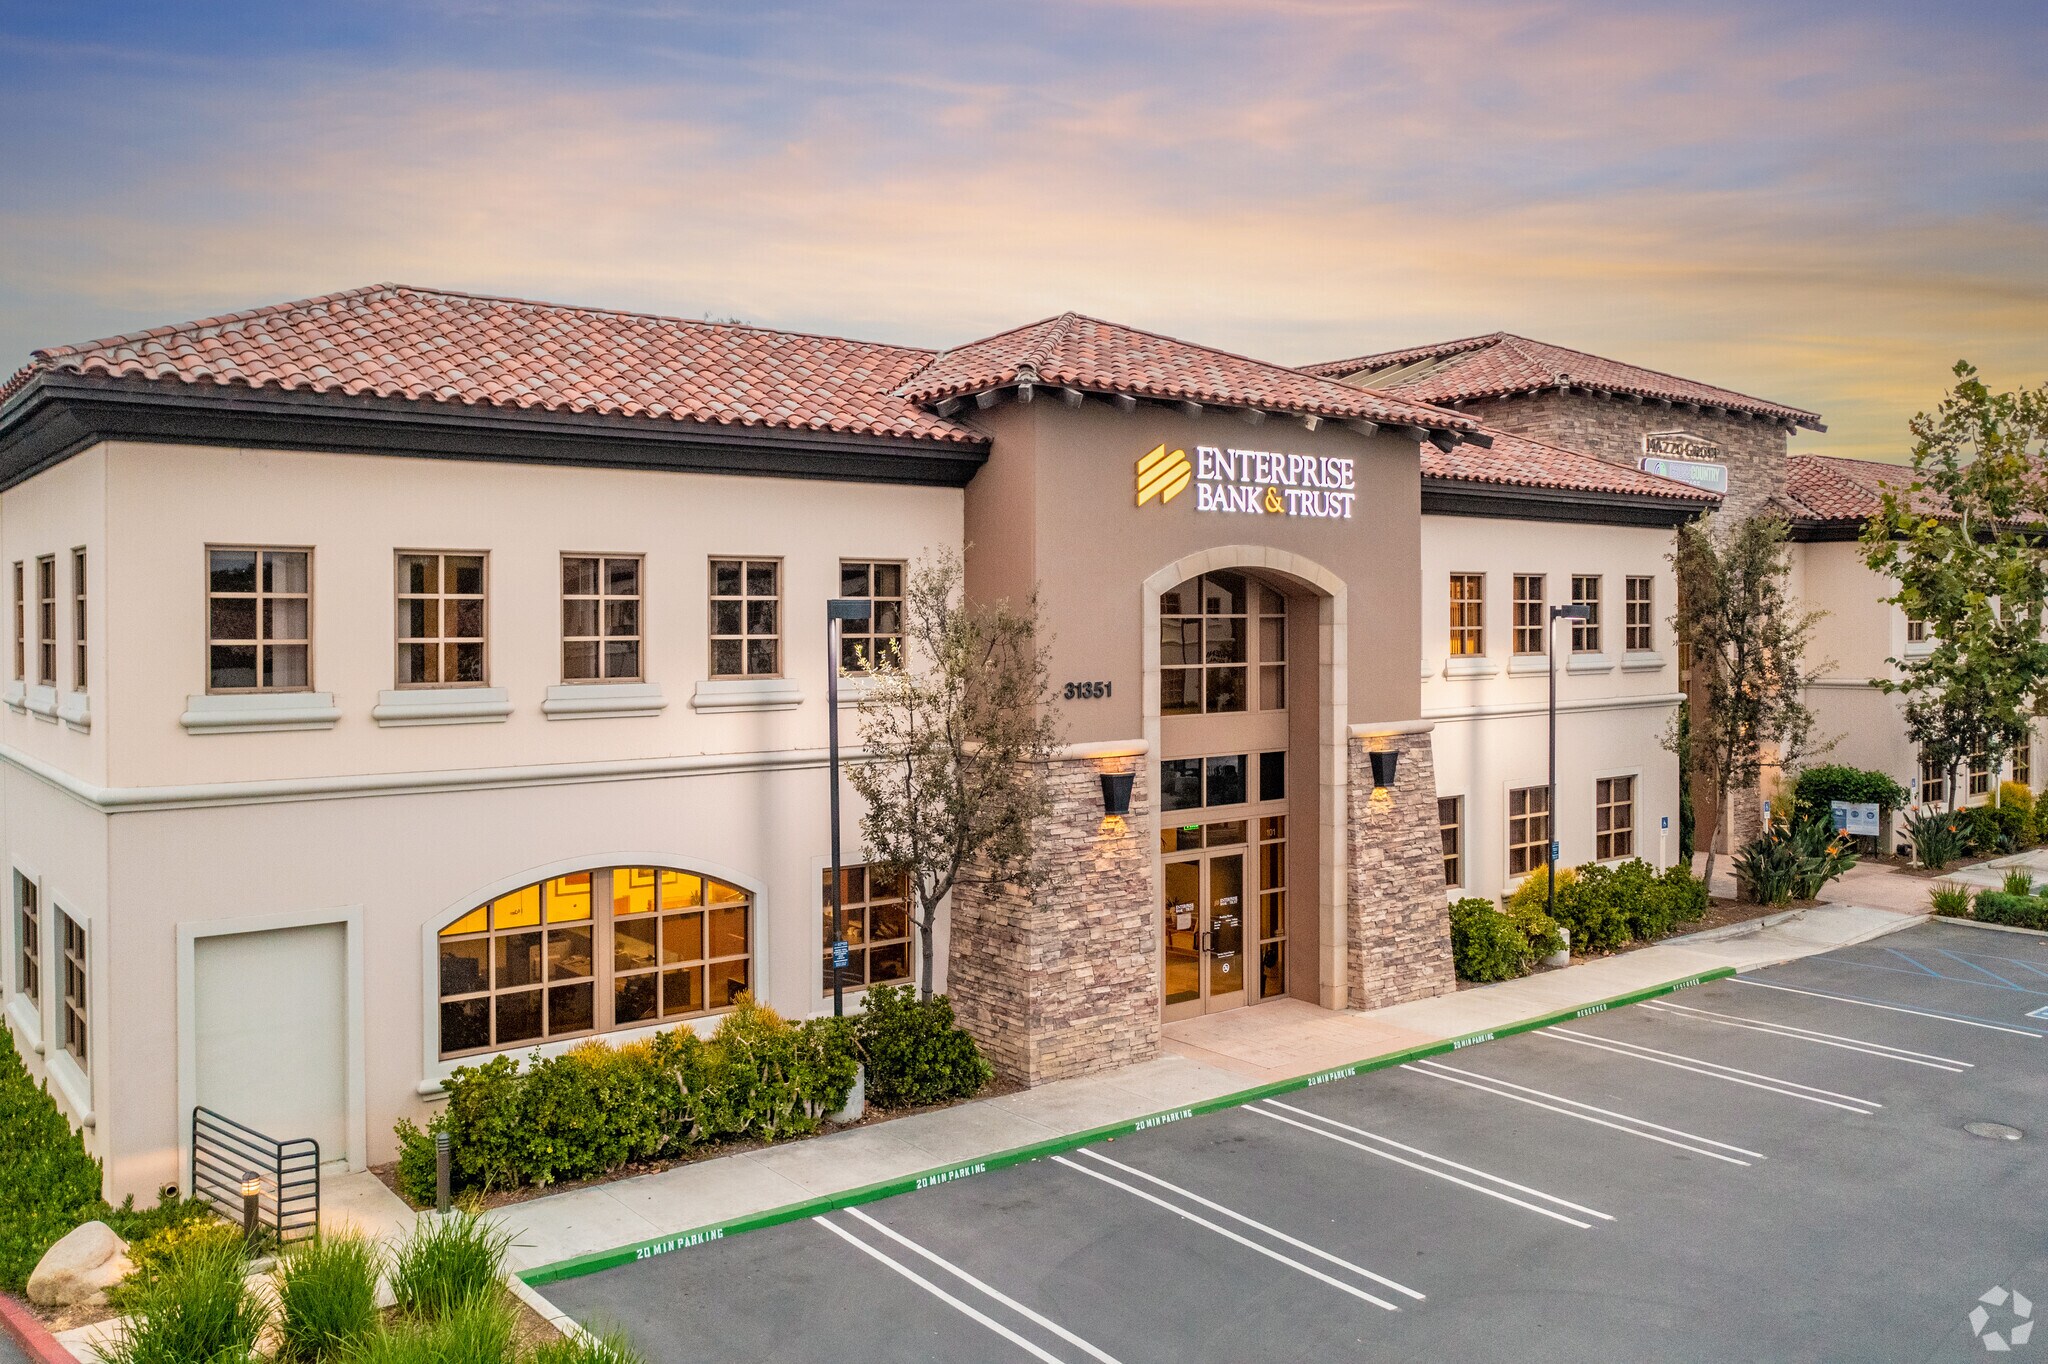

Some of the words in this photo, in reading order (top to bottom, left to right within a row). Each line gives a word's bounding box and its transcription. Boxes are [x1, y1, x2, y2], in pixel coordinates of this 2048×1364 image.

[1196, 446, 1355, 490] ENTERPRISE
[1197, 482, 1264, 514] BANK
[1265, 486, 1285, 513] &
[1284, 488, 1356, 519] TRUST
[1064, 681, 1112, 700] 31351
[1577, 1003, 1607, 1018] RESERVED
[1453, 1041, 1461, 1049] 20
[1461, 1038, 1471, 1047] MIN
[1472, 1032, 1494, 1044] PARKING
[1307, 1077, 1316, 1086] 20
[1317, 1074, 1329, 1084] MIN
[1330, 1067, 1356, 1080] PARKING
[1135, 1120, 1145, 1130] 20
[1146, 1117, 1160, 1128] MIN
[1161, 1109, 1192, 1124] PARKING
[916, 1177, 928, 1189] 20
[929, 1172, 947, 1186] MIN
[948, 1163, 986, 1181] PARKING
[636, 1246, 651, 1259] 20
[653, 1240, 675, 1255] MIN
[677, 1228, 724, 1248] PARKING
